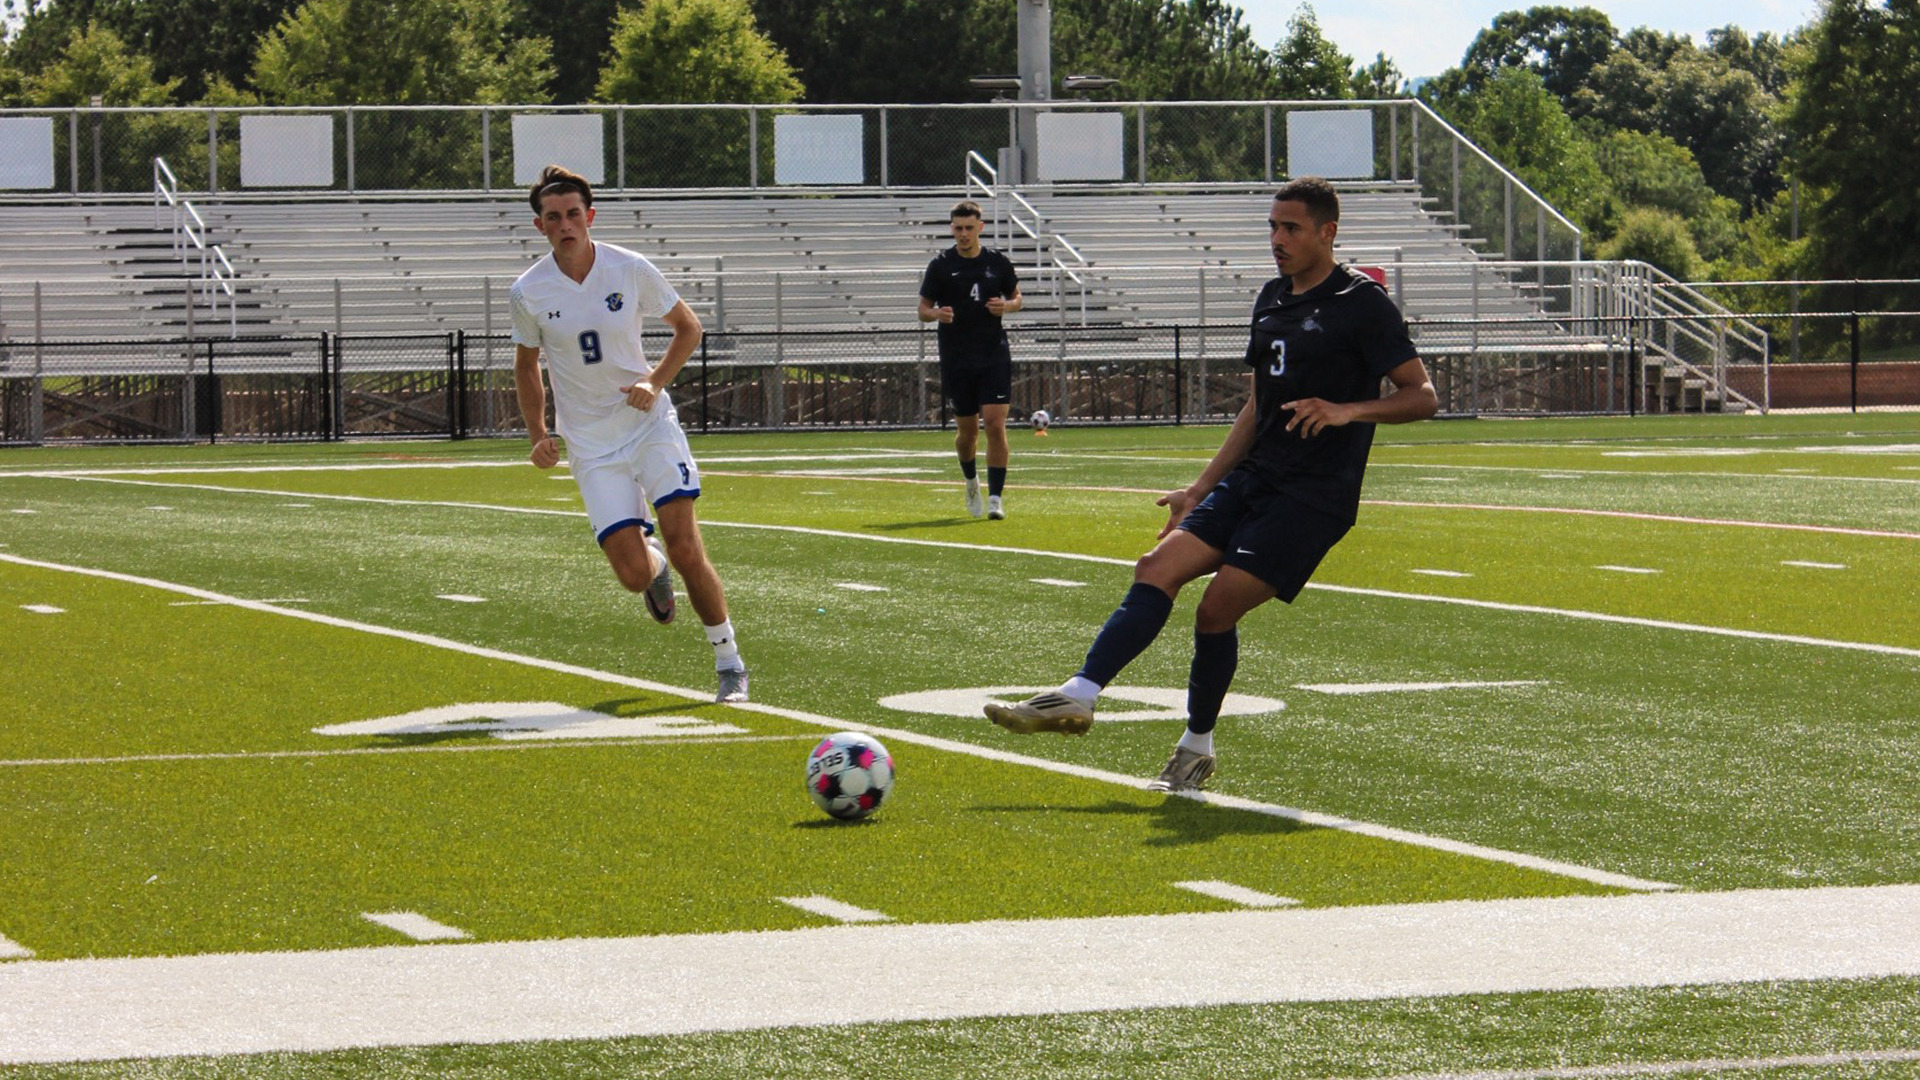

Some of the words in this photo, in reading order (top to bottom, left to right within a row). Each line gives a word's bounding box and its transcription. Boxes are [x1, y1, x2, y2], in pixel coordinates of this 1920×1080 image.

[970, 282, 980, 301] 4
[578, 329, 603, 365] 9
[1270, 340, 1285, 376] 3
[677, 462, 690, 486] 9
